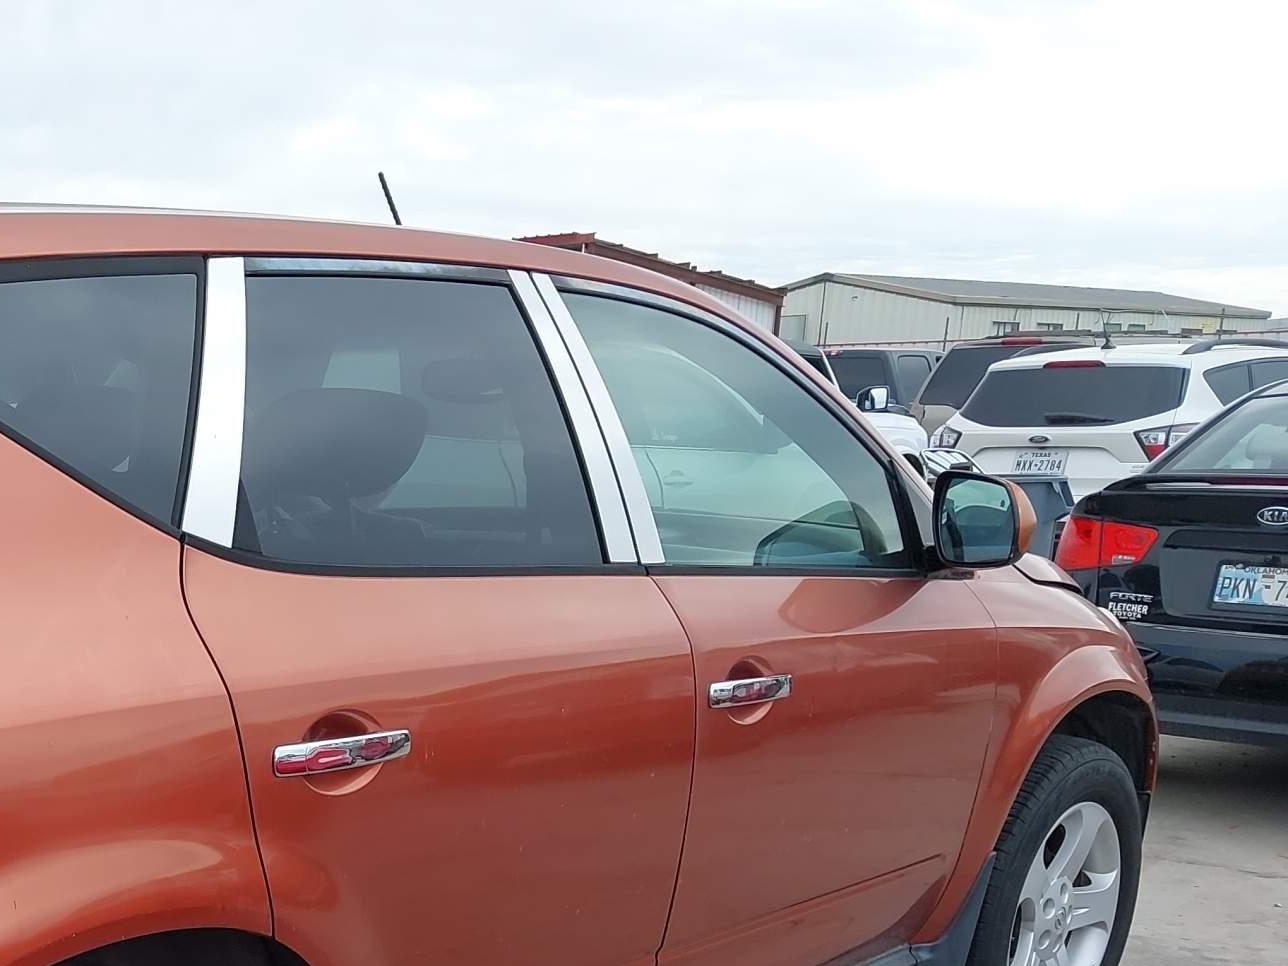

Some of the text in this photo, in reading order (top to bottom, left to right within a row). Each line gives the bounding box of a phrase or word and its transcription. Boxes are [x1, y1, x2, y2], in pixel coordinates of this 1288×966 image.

[1263, 510, 1288, 522] KIA
[1109, 591, 1154, 603] FORTE
[1108, 602, 1149, 616] FLETCHER
[1113, 610, 1142, 619] TOYOTA
